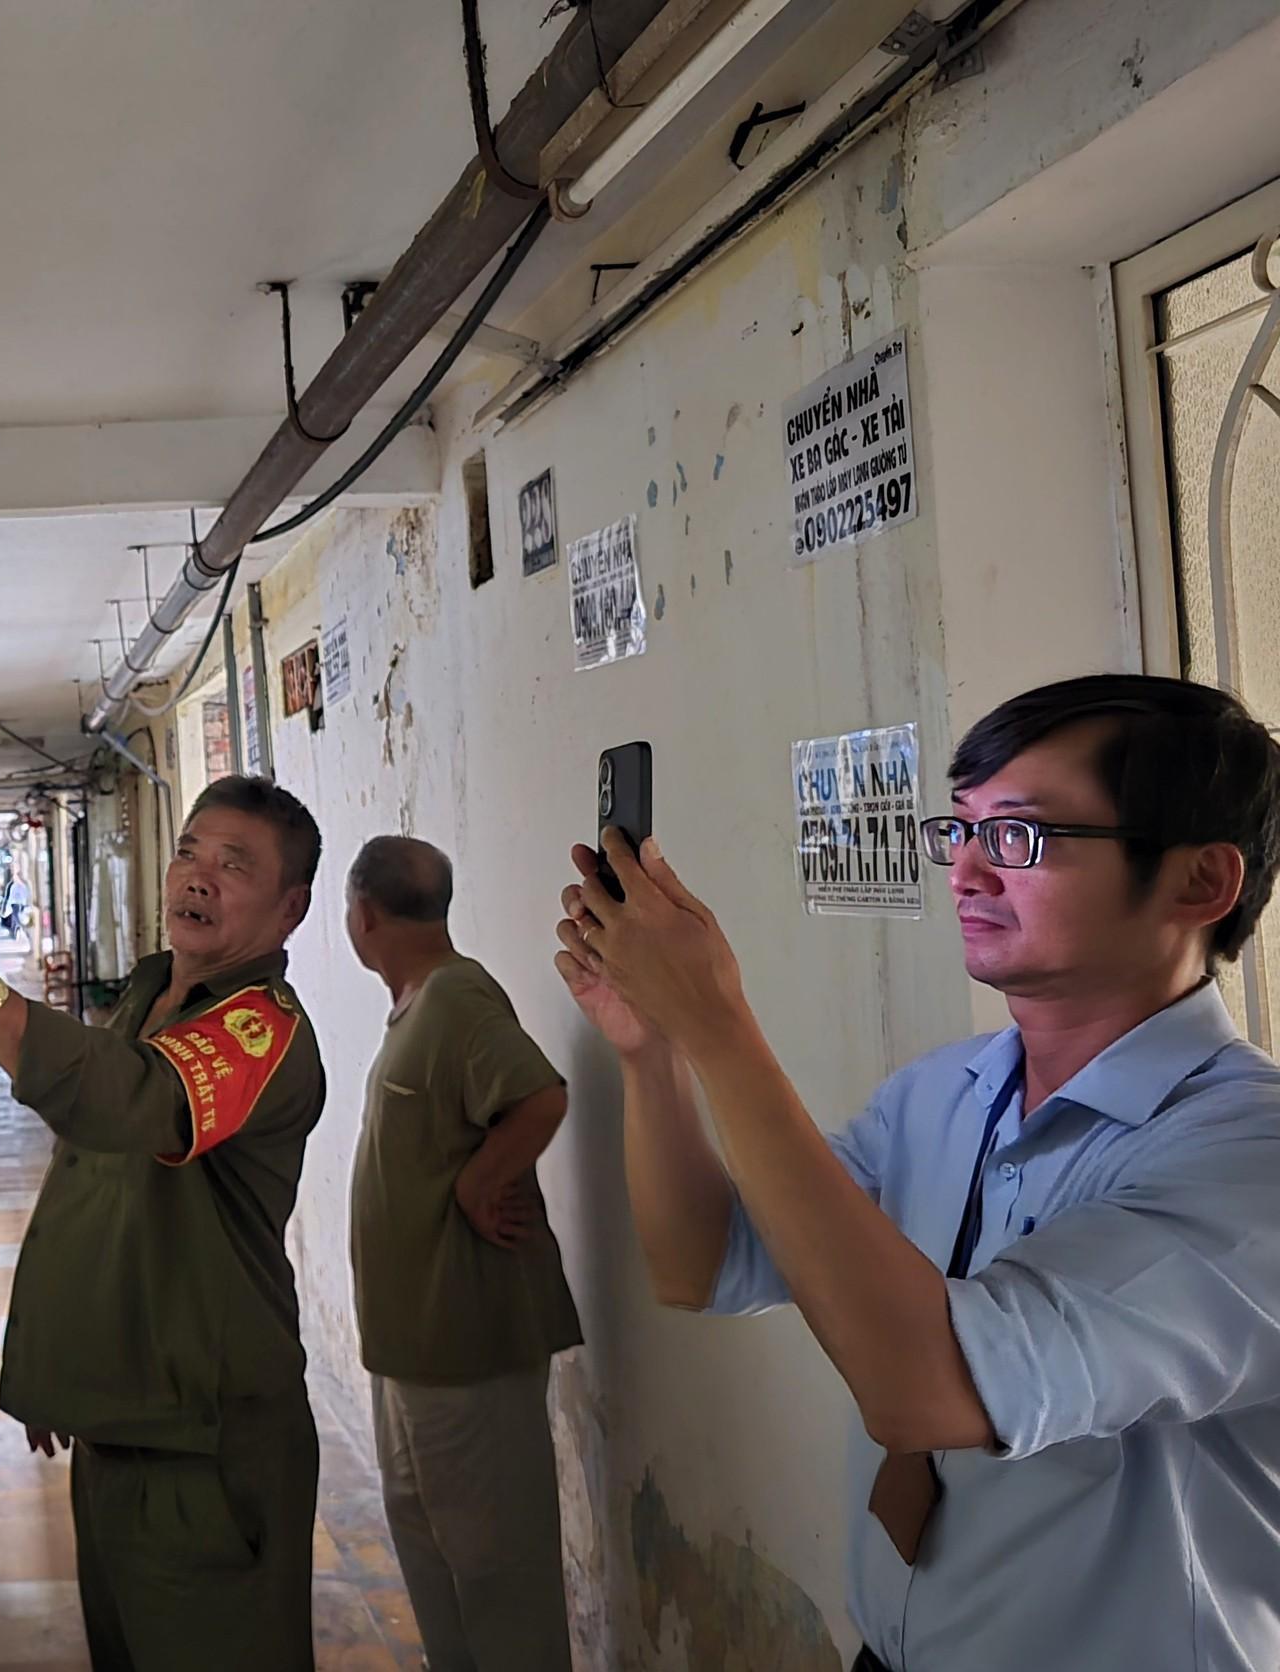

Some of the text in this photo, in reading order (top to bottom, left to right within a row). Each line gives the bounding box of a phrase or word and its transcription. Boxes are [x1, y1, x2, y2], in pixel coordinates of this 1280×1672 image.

[787, 366, 880, 446] CHUYỂN NHÀ
[790, 452, 805, 484] XE
[806, 443, 822, 475] BA
[824, 427, 849, 465] GÁC
[861, 412, 879, 448] XE
[882, 393, 905, 436] TẢI
[804, 472, 912, 552] 0902225497
[870, 751, 912, 797] NHÀ
[212, 1056, 234, 1080] VỆ
